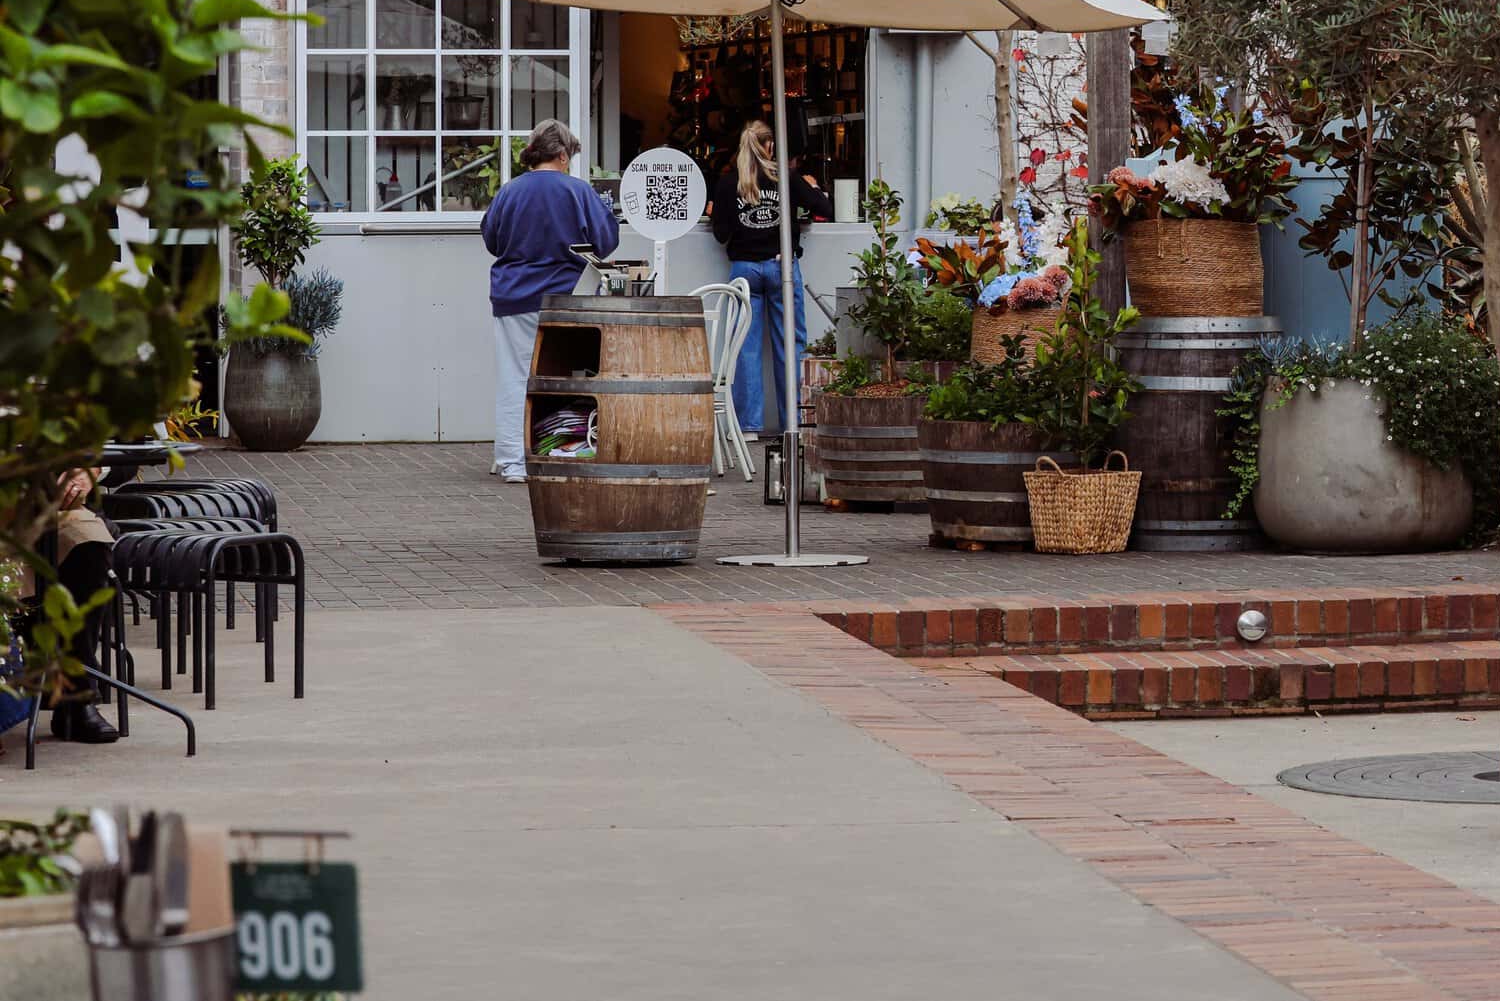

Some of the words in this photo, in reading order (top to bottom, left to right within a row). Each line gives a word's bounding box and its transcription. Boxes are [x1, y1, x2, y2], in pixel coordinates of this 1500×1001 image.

[631, 163, 648, 173] SCAN
[652, 163, 673, 173] ORDER
[678, 163, 694, 173] WAIT
[238, 910, 335, 980] 906
